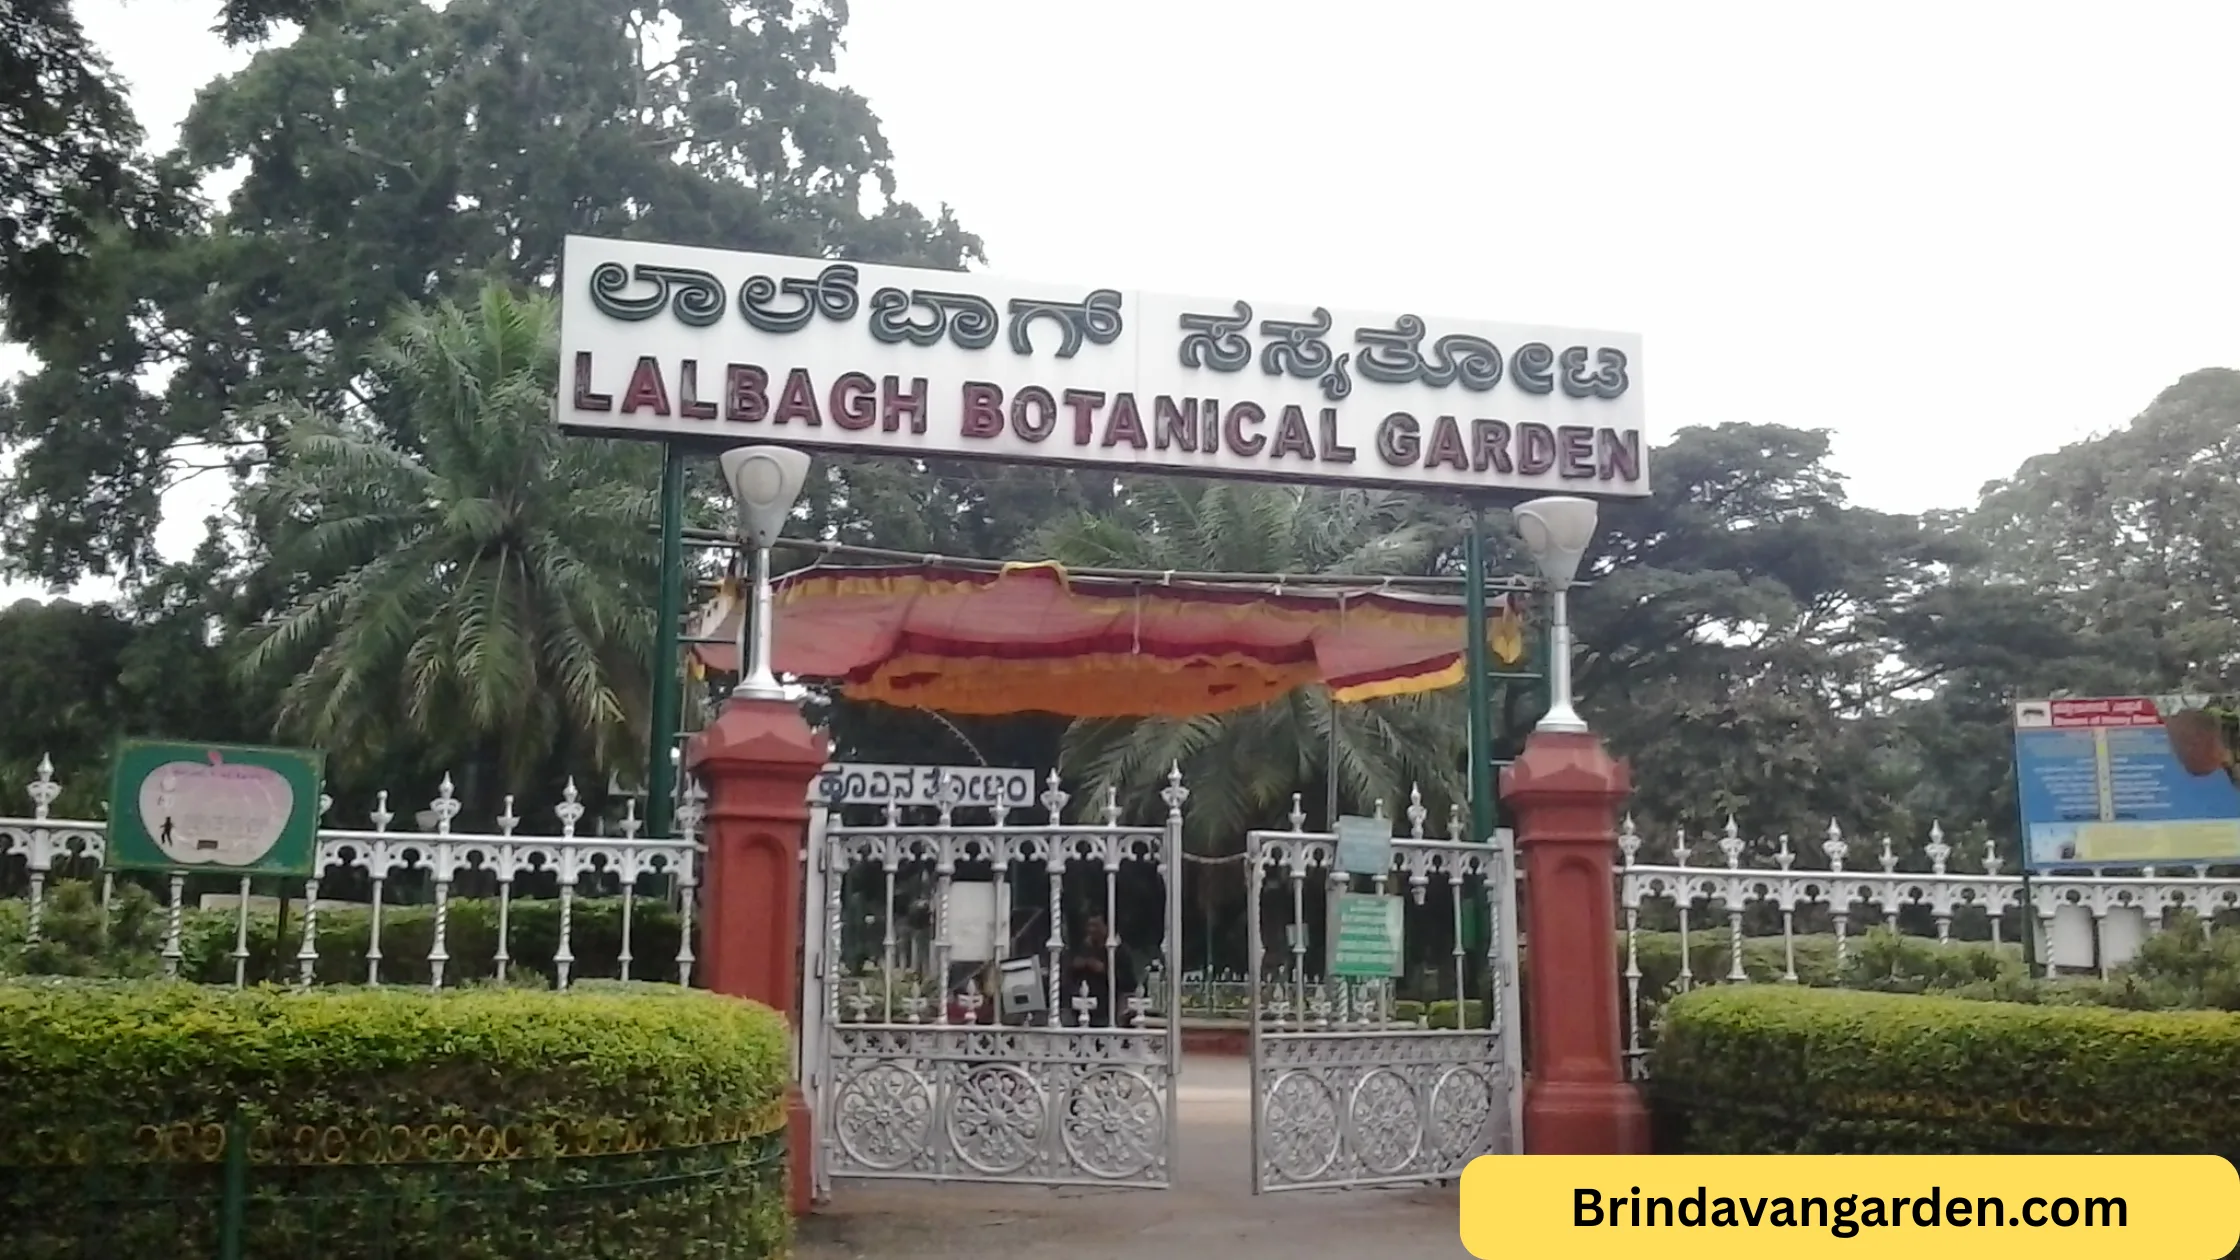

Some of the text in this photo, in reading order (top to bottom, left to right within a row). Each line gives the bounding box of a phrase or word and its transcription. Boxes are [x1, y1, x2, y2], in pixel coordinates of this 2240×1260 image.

[1179, 300, 1629, 400] ಸಸ್ಯತೋಟ
[574, 351, 1640, 482] LALBAGH BOTANICAL GARDEN
